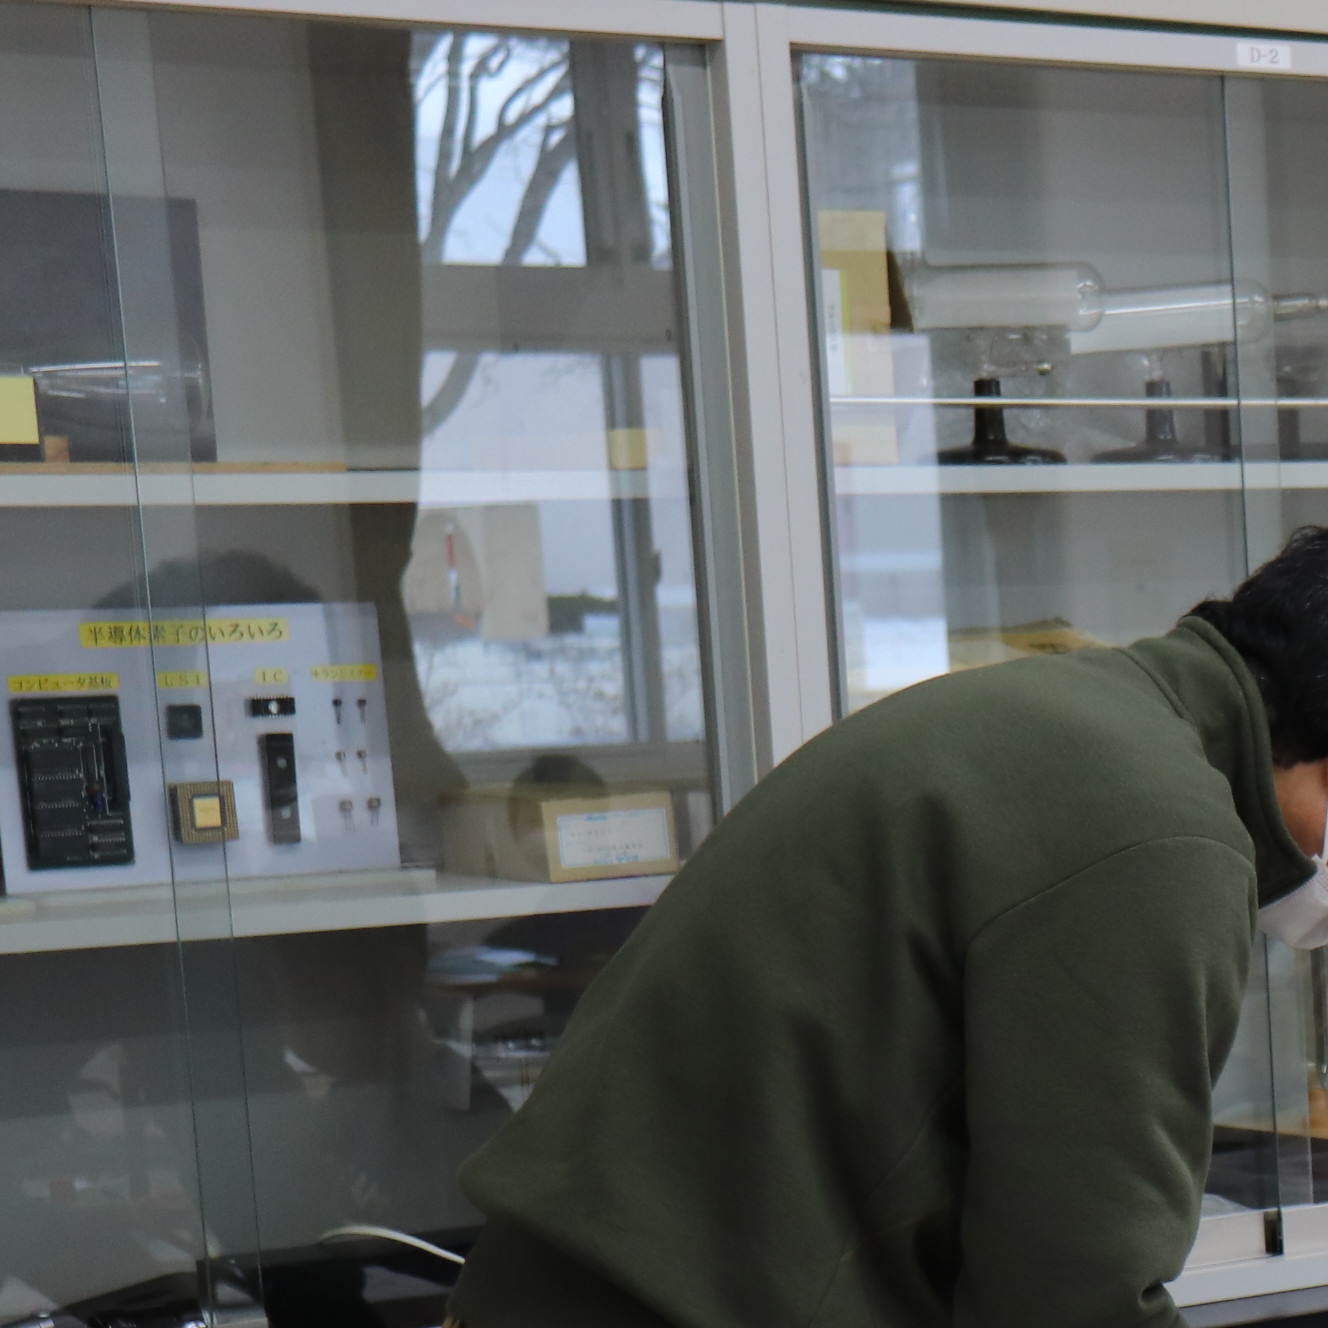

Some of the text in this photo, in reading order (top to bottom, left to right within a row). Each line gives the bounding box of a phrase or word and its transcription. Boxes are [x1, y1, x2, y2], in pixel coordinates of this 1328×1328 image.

[1249, 47, 1280, 65] D-2
[88, 621, 285, 645] 半導体素子のいろいろ
